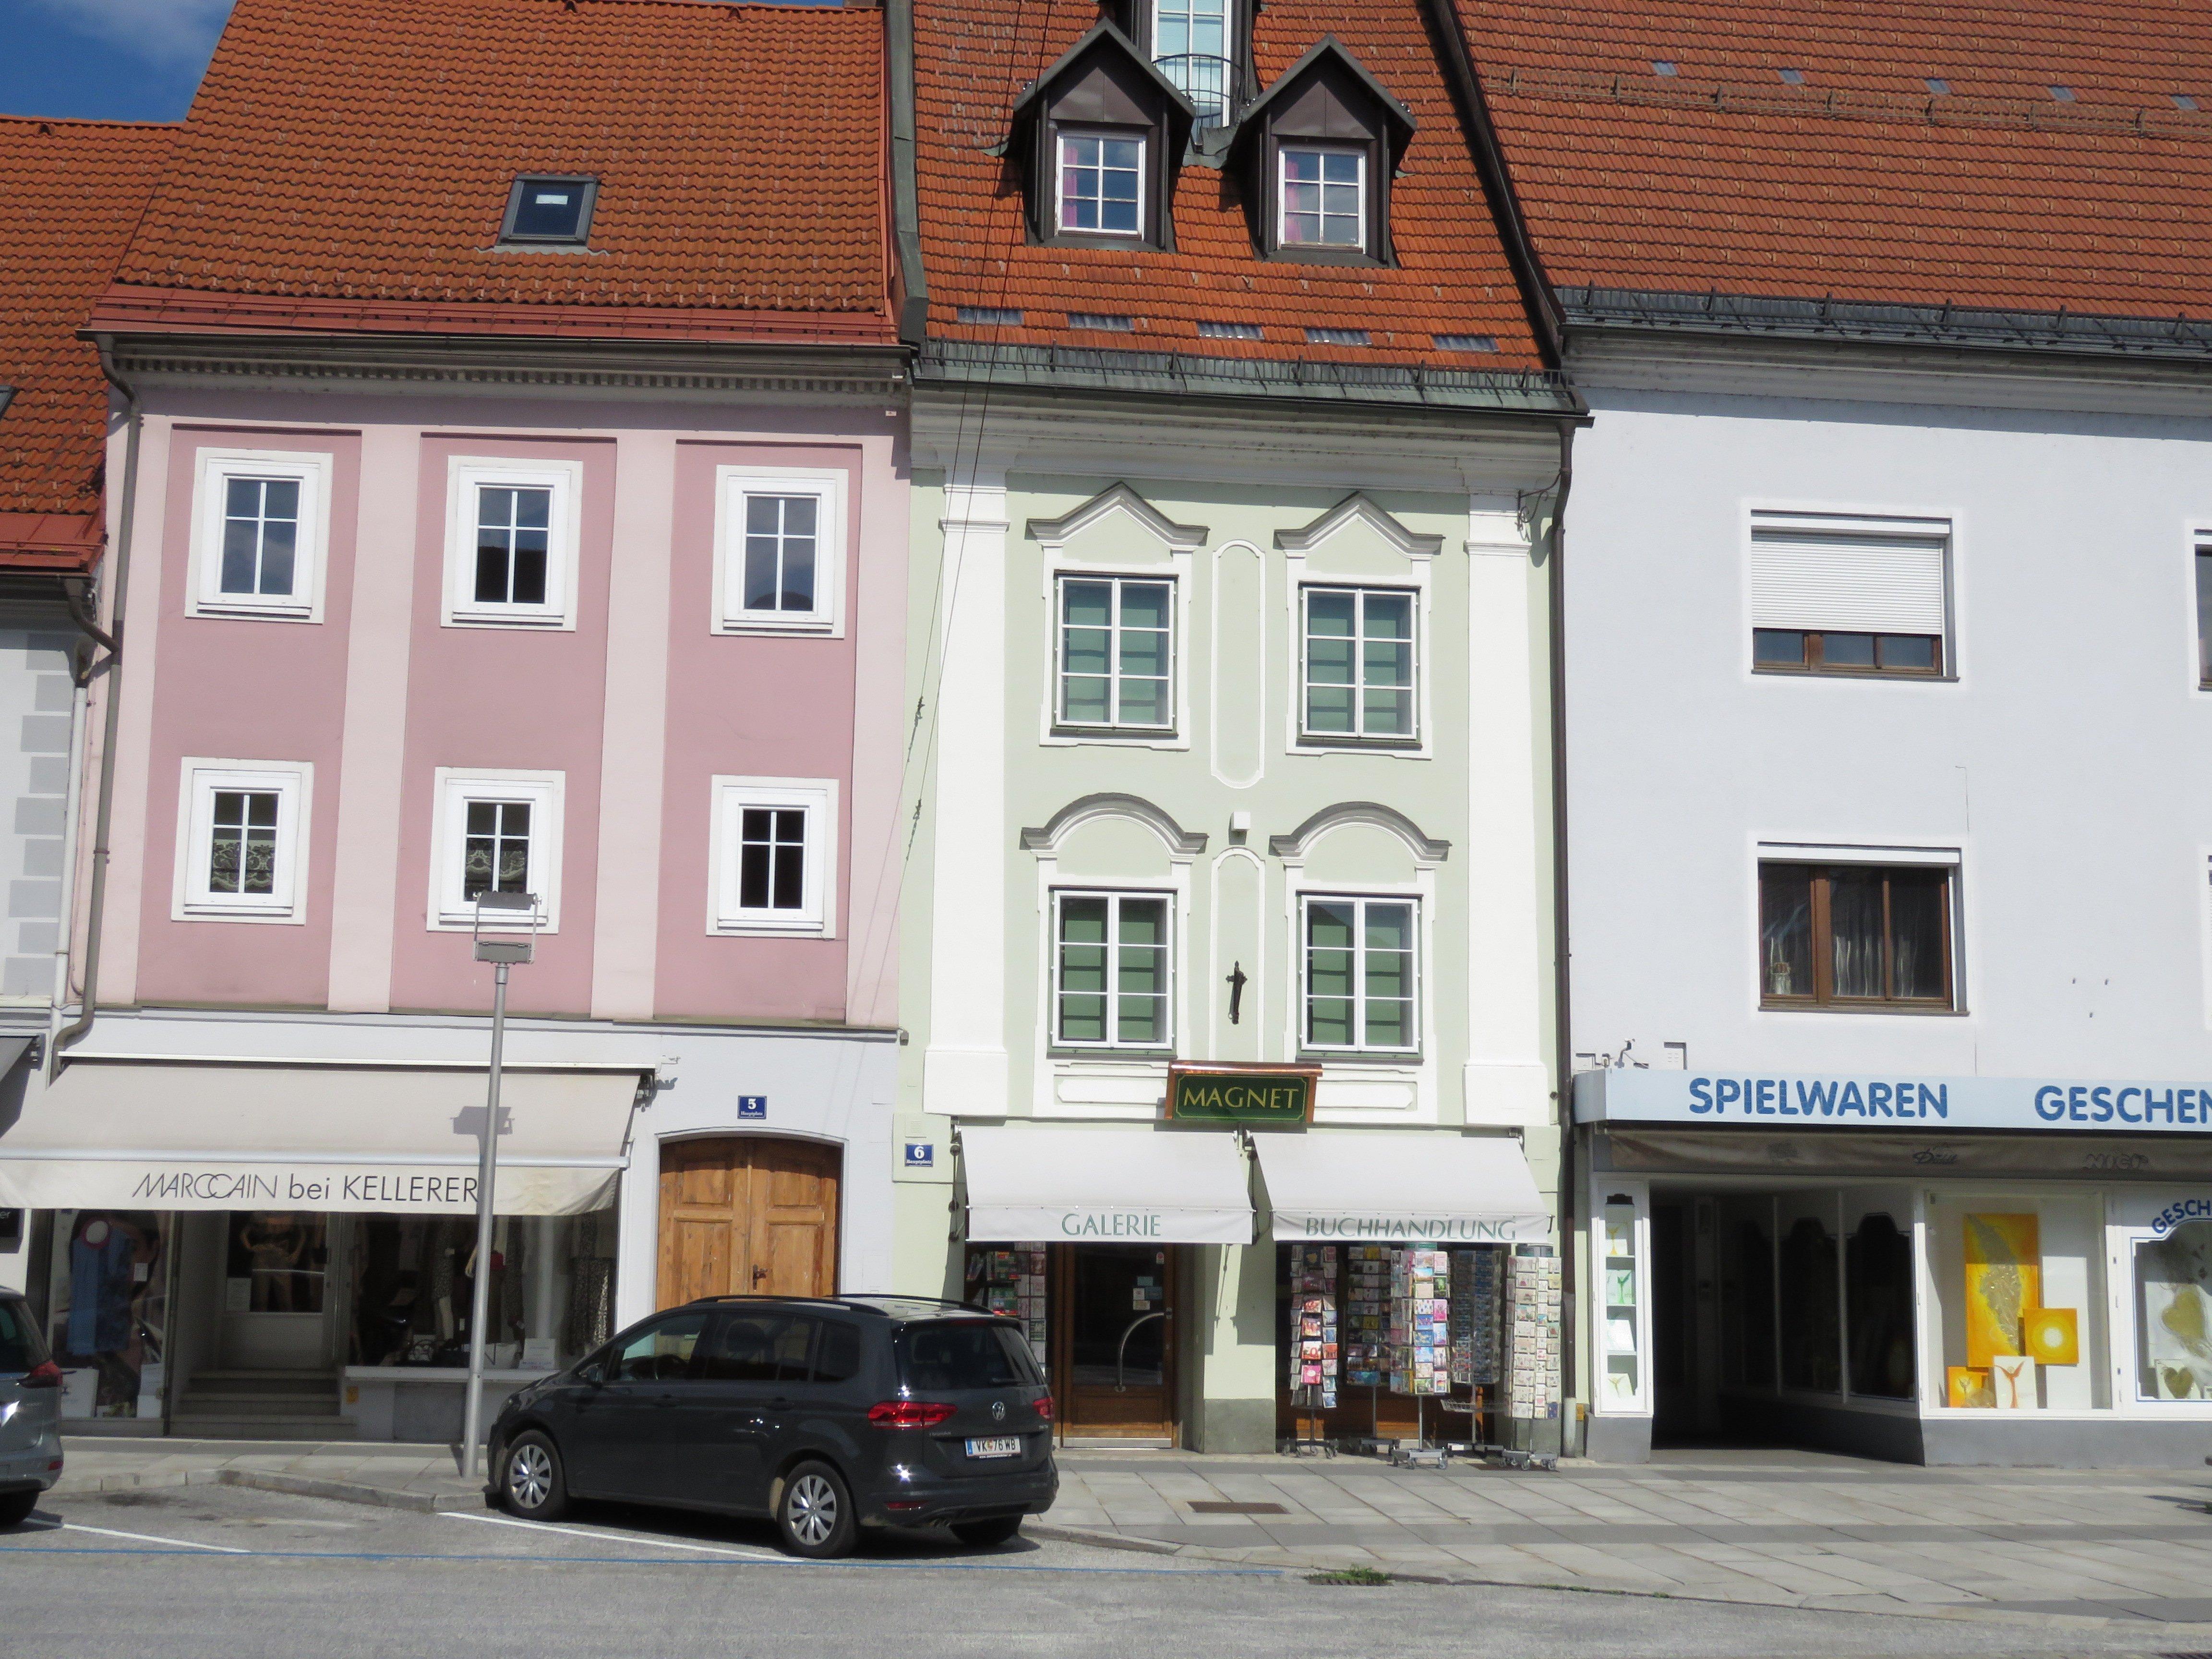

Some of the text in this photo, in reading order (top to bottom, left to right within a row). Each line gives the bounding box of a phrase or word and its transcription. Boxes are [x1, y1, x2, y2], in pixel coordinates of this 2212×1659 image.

[748, 1098, 757, 1110] 5
[1184, 1086, 1299, 1109] MAGNET
[1689, 1078, 1948, 1118] SPIELWAREN
[914, 1146, 925, 1159] 6
[289, 1173, 331, 1200] bei
[343, 1175, 479, 1202] KELLERER
[1061, 1213, 1161, 1236] GALERIE
[2152, 1199, 2211, 1234] GESCH
[1305, 1217, 1516, 1240] BUCHHANDLUNG
